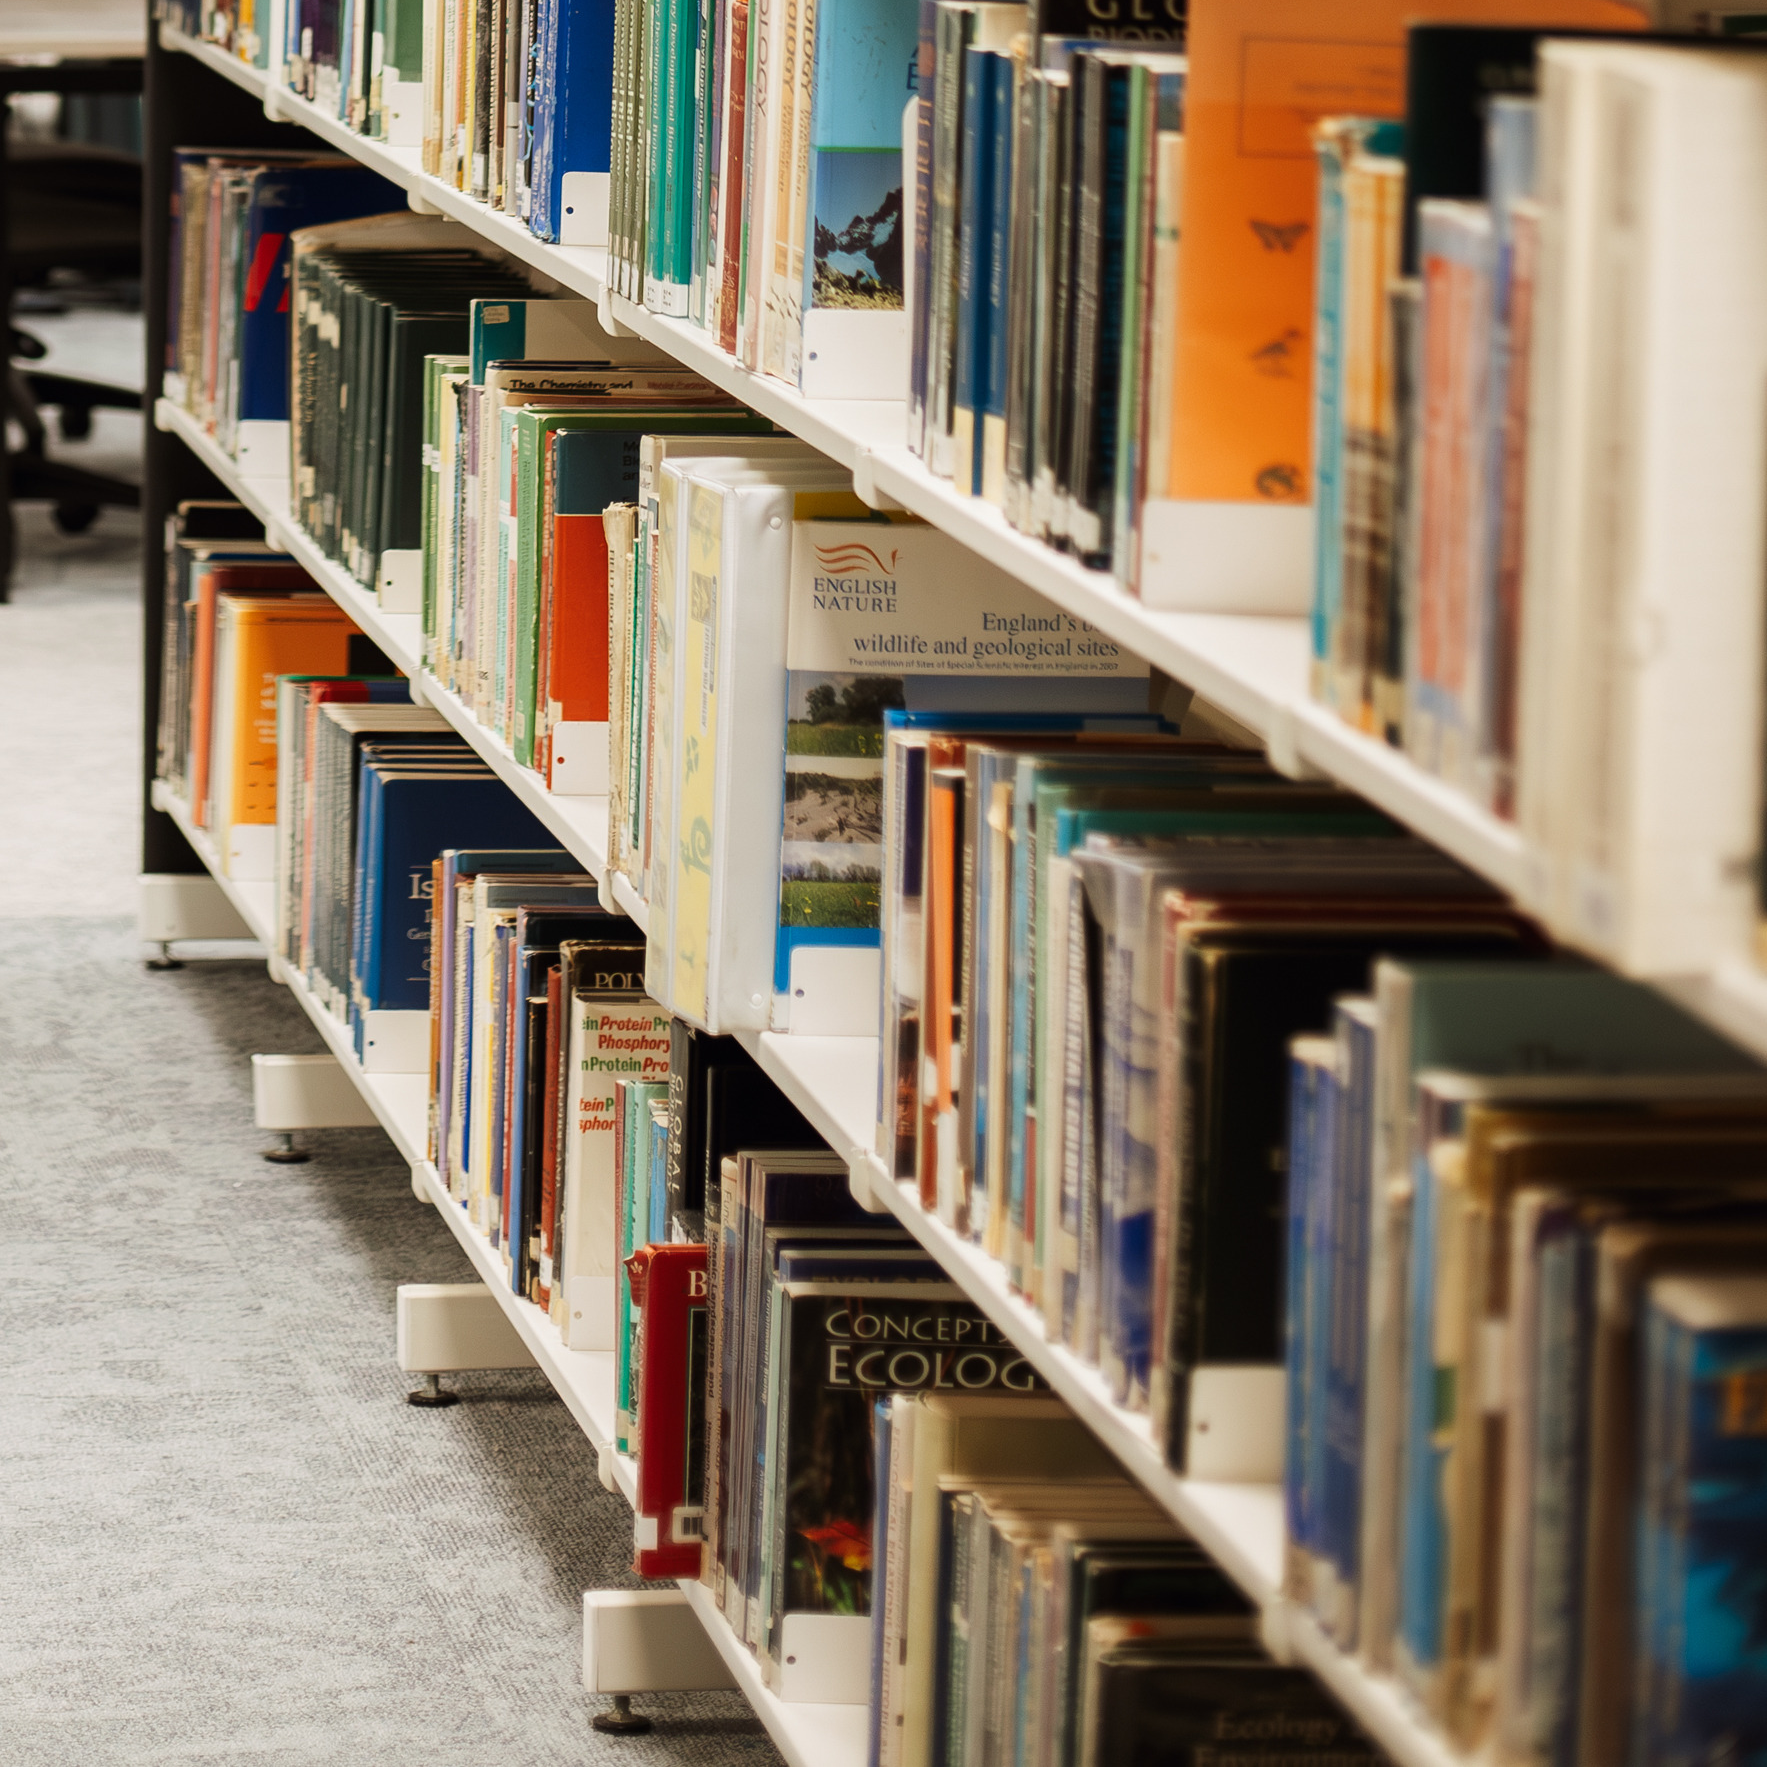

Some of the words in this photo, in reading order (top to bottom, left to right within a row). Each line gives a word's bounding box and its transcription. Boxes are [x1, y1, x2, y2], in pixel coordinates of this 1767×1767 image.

[652, 21, 660, 121] Developmental
[668, 23, 677, 122] Developmental
[698, 29, 706, 140] Developmental
[624, 102, 633, 179] Biology
[666, 126, 675, 178] Biology
[510, 378, 536, 389] The
[540, 378, 607, 390] Chemistry
[608, 380, 633, 389] and
[813, 596, 897, 613] NATURE
[814, 576, 897, 596] ENGLISH
[848, 657, 863, 666] The
[864, 657, 904, 667] condition
[916, 658, 934, 667] Sites
[947, 659, 973, 670] Special
[1012, 661, 1045, 670] Interest
[1055, 662, 1089, 672] England
[854, 634, 928, 655] wildlife
[933, 636, 967, 655] and
[973, 638, 1072, 661] geological
[1077, 639, 1119, 657] sites
[599, 1016, 653, 1032] Protein
[598, 1034, 671, 1054] Phosphory
[590, 1057, 642, 1072] Protein
[667, 1072, 676, 1192] BIODIVERSITY
[671, 1075, 684, 1196] GLOBAL
[709, 1284, 717, 1367] Landscapes
[826, 1309, 1009, 1346] CONCEPT
